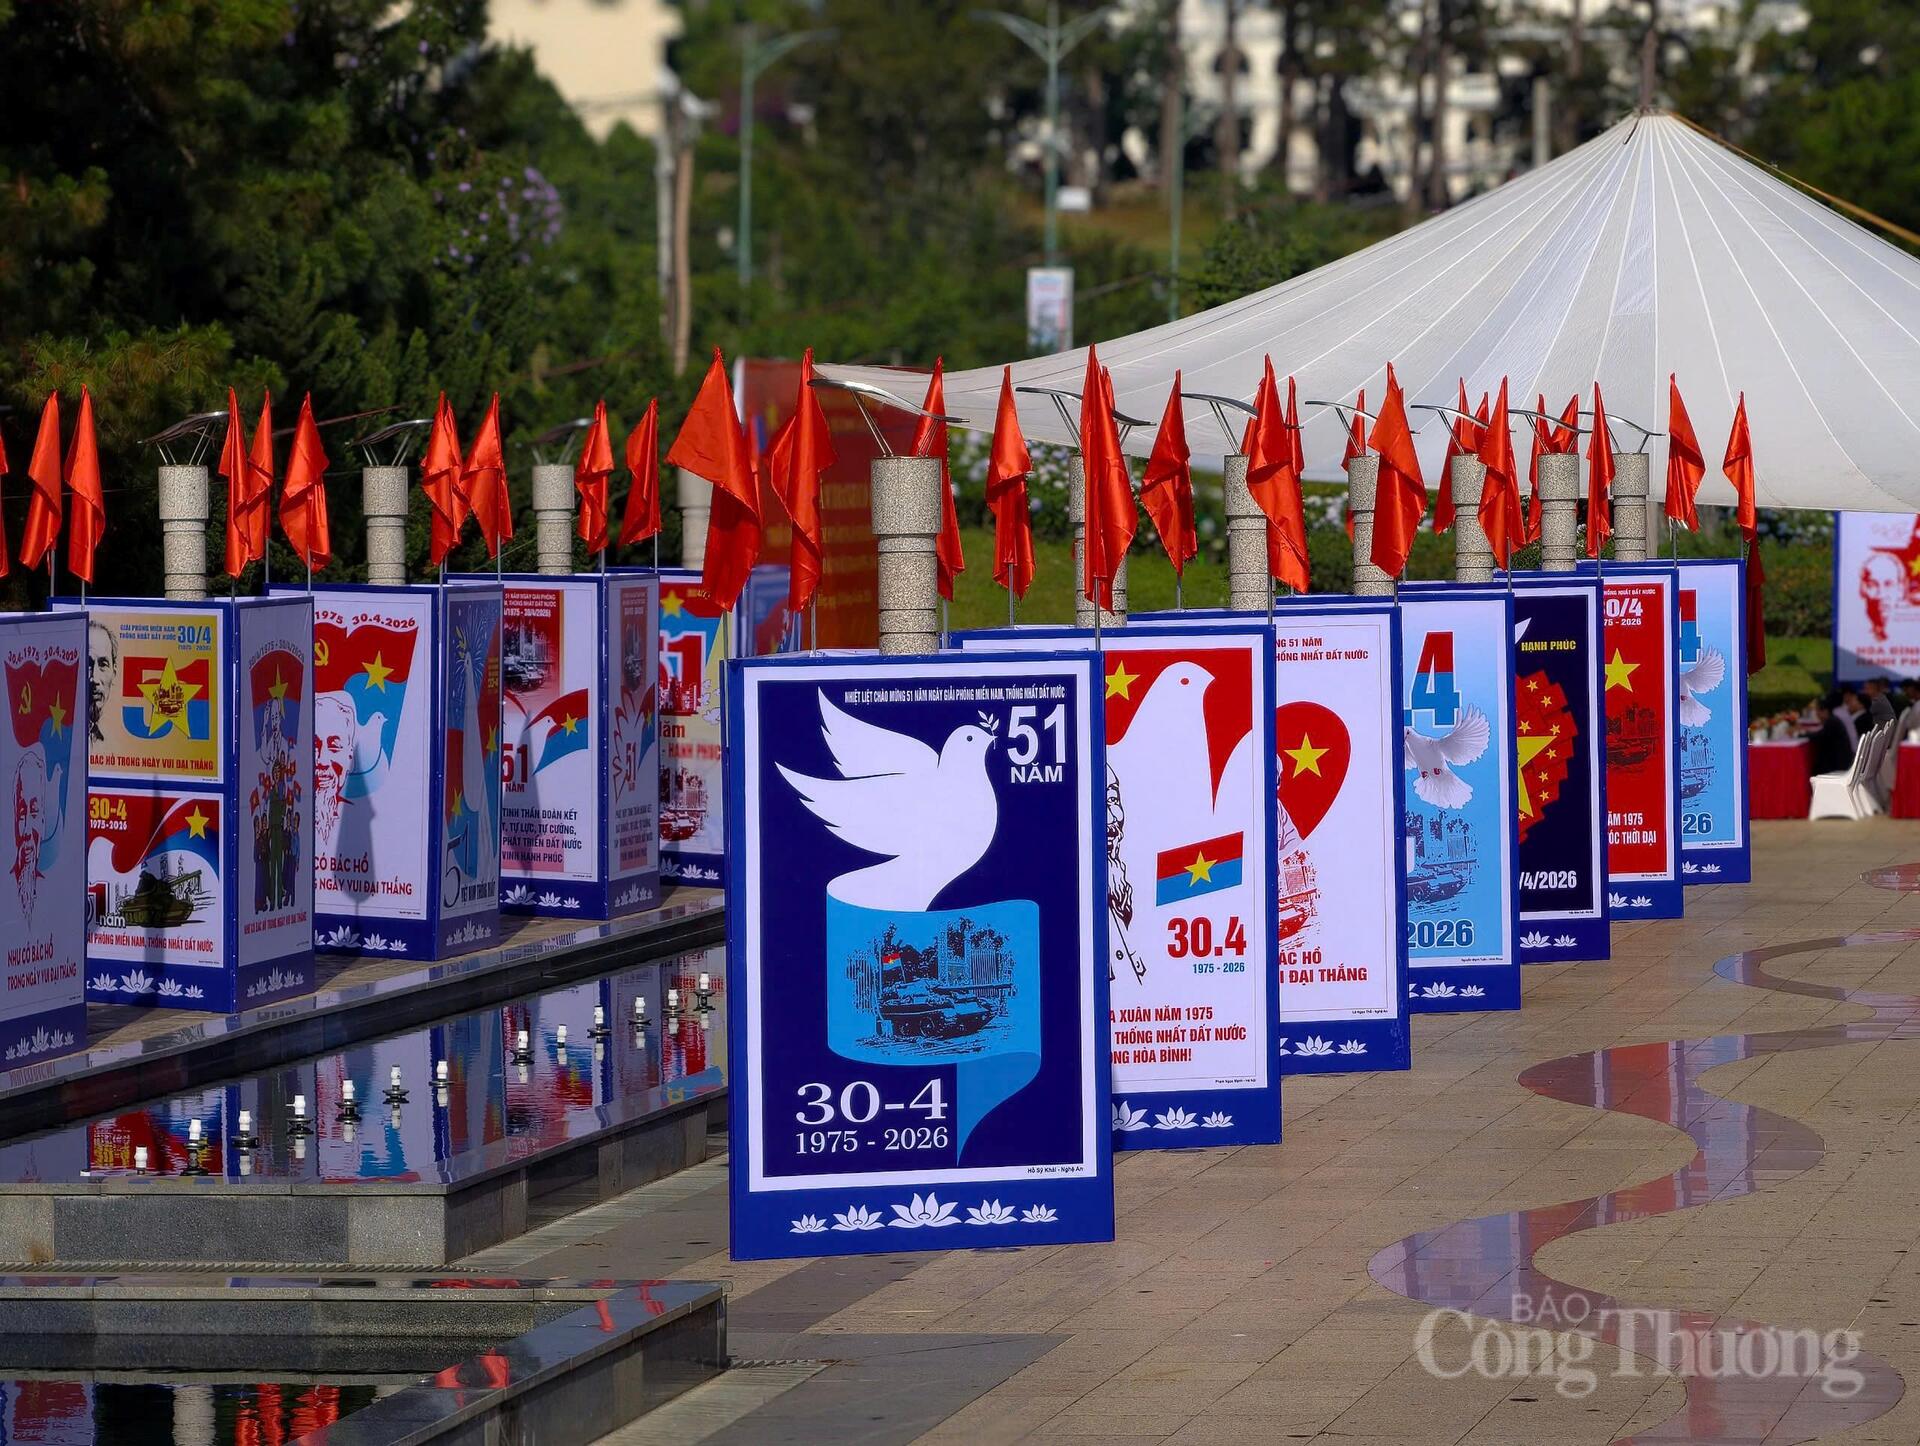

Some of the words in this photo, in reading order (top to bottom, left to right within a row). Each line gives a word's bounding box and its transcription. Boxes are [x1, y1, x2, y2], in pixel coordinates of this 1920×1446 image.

[1604, 598, 1643, 617] 0/4
[315, 611, 343, 624] 1975
[352, 613, 416, 628] 30.4.2026
[1621, 618, 1641, 626] 2026
[178, 625, 211, 643] 30/4
[1288, 638, 1299, 648] 51
[1302, 636, 1322, 647] NĂM
[1301, 649, 1323, 660] NHẤT
[1326, 648, 1342, 660] ĐẤT
[1345, 649, 1369, 660] NƯỚC
[1521, 641, 1547, 653] HẠNH
[1551, 638, 1576, 650] PHÚC
[122, 655, 210, 740] 51
[845, 688, 860, 705] NHIỆT
[861, 688, 872, 705] LIỆT
[873, 688, 888, 703] CHÀO
[889, 687, 905, 702] MỪNG
[906, 690, 913, 702] 51
[914, 687, 927, 702] NĂM
[928, 686, 943, 701] NGÀY
[943, 685, 955, 701] GIẢI
[956, 686, 974, 701] PHÓNG
[990, 688, 1005, 701] NAM,
[1006, 683, 1023, 700] THỐNG
[1024, 682, 1038, 699] NHẤT
[1039, 682, 1049, 699] ĐẤT
[1050, 683, 1065, 698] NƯỚC
[1007, 704, 1066, 766] 51
[1010, 763, 1063, 783] NĂM
[90, 798, 127, 820] 30-4
[502, 808, 519, 817] TINH
[521, 807, 540, 819] THẦN
[542, 809, 562, 820] ĐOÀN
[564, 807, 578, 820] KẾT
[90, 820, 127, 830] 1975-2026
[1623, 812, 1643, 826] 1975
[1622, 828, 1641, 844] THỜI
[1642, 830, 1657, 846] ĐẠI
[330, 853, 351, 872] BÁC
[353, 852, 369, 874] HỒ
[319, 877, 344, 892] NGÀY
[347, 880, 362, 893] VUI
[364, 881, 379, 897] ĐẠI
[380, 876, 412, 896] THẮNG
[99, 912, 126, 928] năm
[1167, 916, 1247, 958] 30.4
[1407, 919, 1474, 949] 2026
[1302, 946, 1322, 965] HỒ
[1193, 963, 1214, 974] 1975
[1223, 962, 1245, 973] 2026
[1289, 969, 1314, 986] ĐẠI
[1319, 963, 1368, 982] THẮNG
[1119, 1006, 1151, 1023] XUÂN
[1154, 1005, 1182, 1022] NĂM
[1185, 1006, 1213, 1020] 1975
[1115, 1024, 1153, 1044] THỐNG
[1156, 1024, 1187, 1043] NHẤT
[1189, 1023, 1212, 1042] ĐẤT
[1215, 1022, 1247, 1041] NƯỚC
[1133, 1046, 1157, 1063] HÒA
[1160, 1045, 1192, 1062] BÌNH!
[795, 1078, 948, 1125] 30-4
[795, 1130, 858, 1155] 1975
[884, 1126, 948, 1151] 2026
